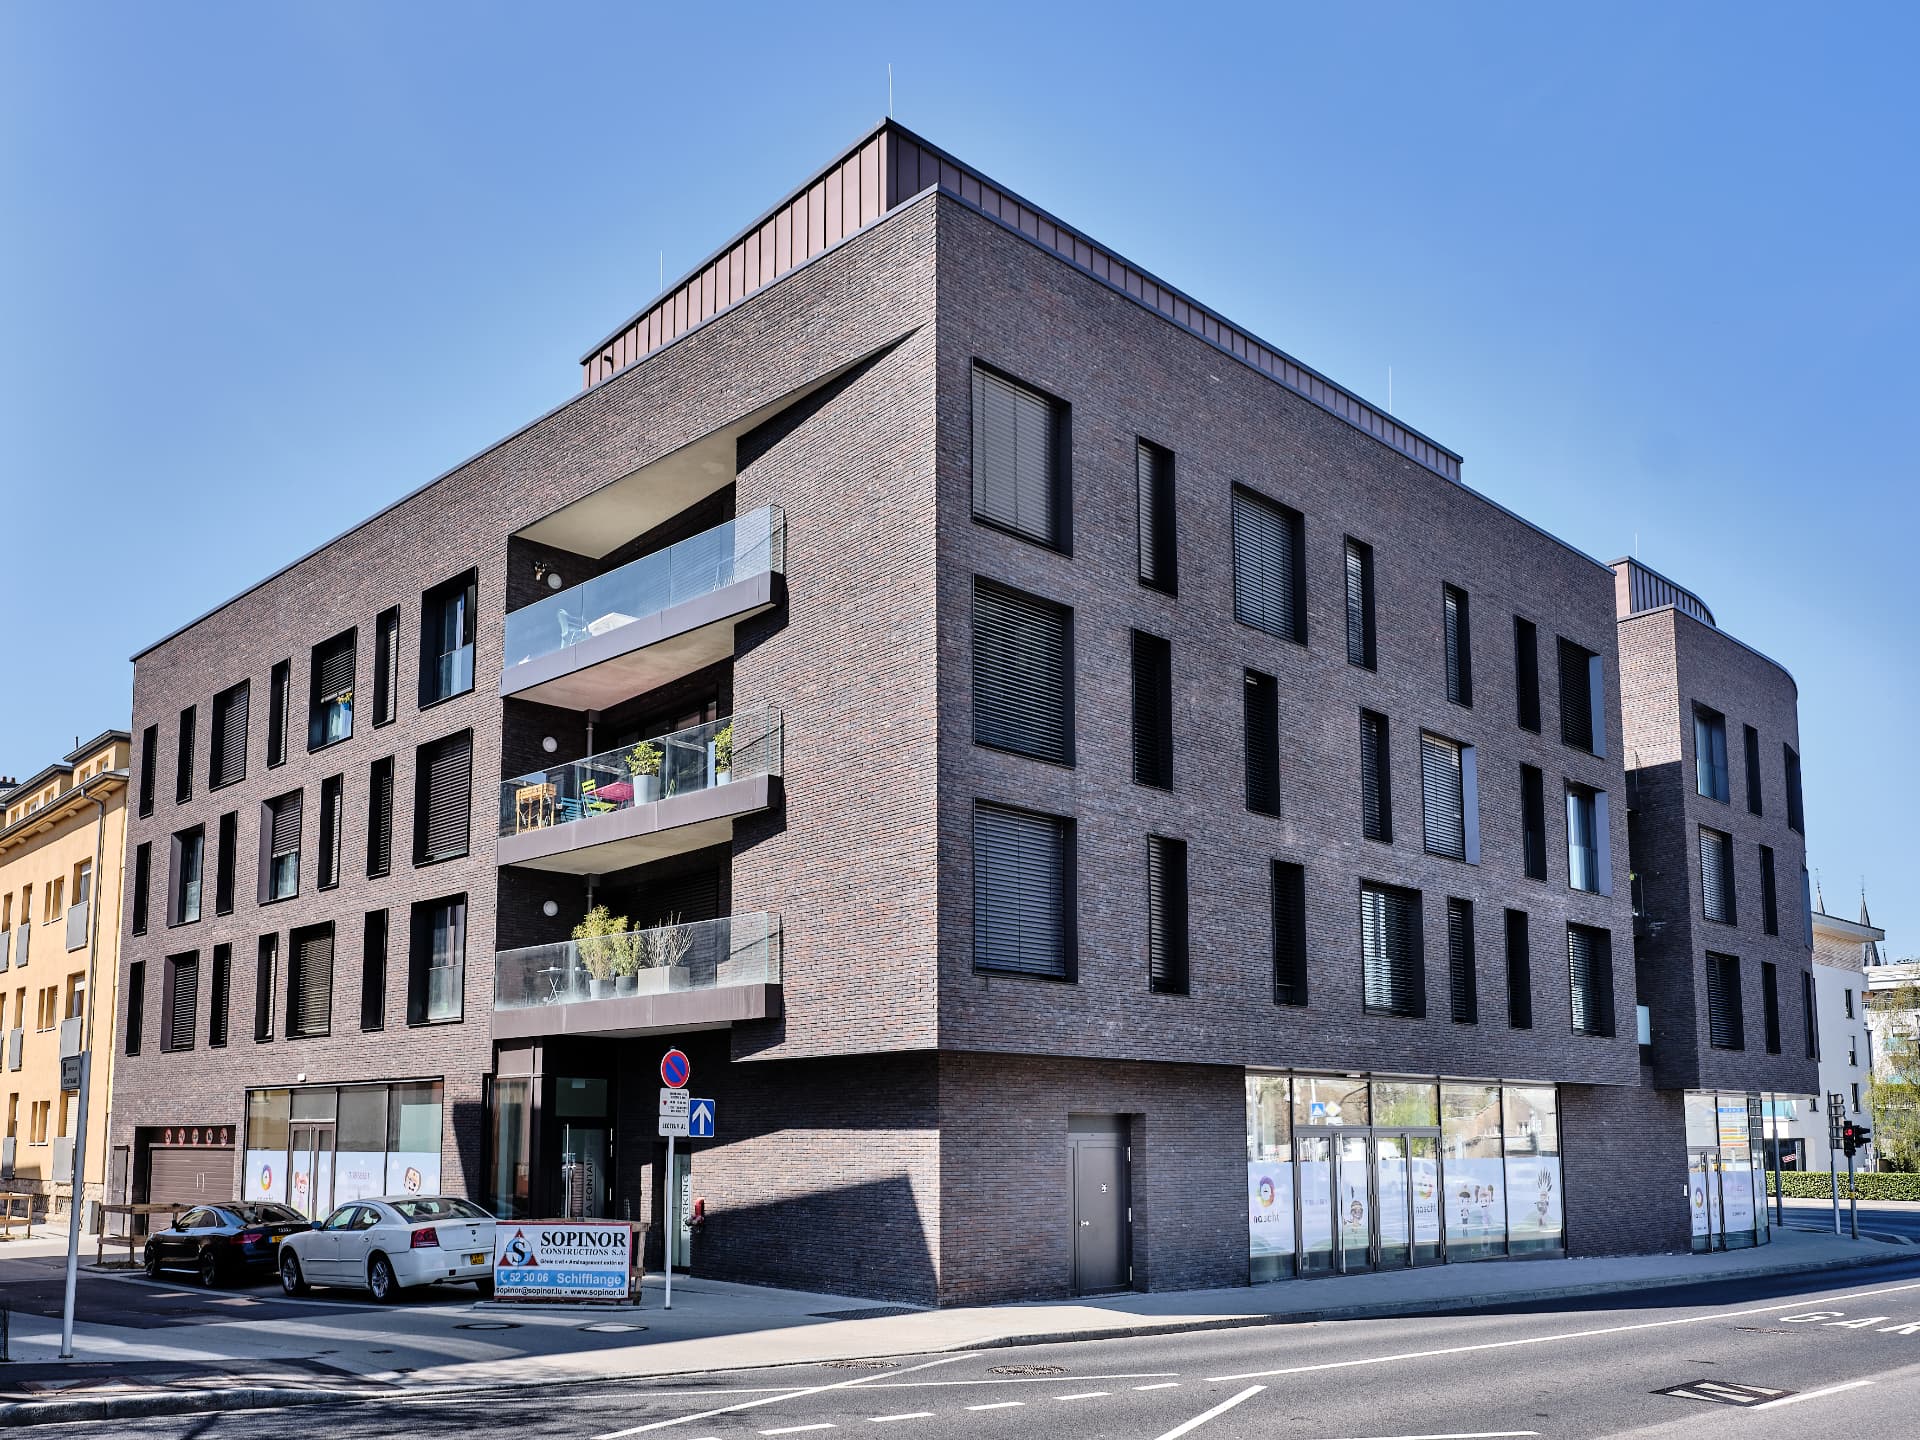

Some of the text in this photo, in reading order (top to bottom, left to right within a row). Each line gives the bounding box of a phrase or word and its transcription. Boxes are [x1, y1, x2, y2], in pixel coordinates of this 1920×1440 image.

[541, 1231, 626, 1247] SOPINOR
[510, 1272, 621, 1287] 52 30 06 Schifflange
[496, 1287, 625, 1296] sopinor@sopinor.lu www.sopinor.lu
